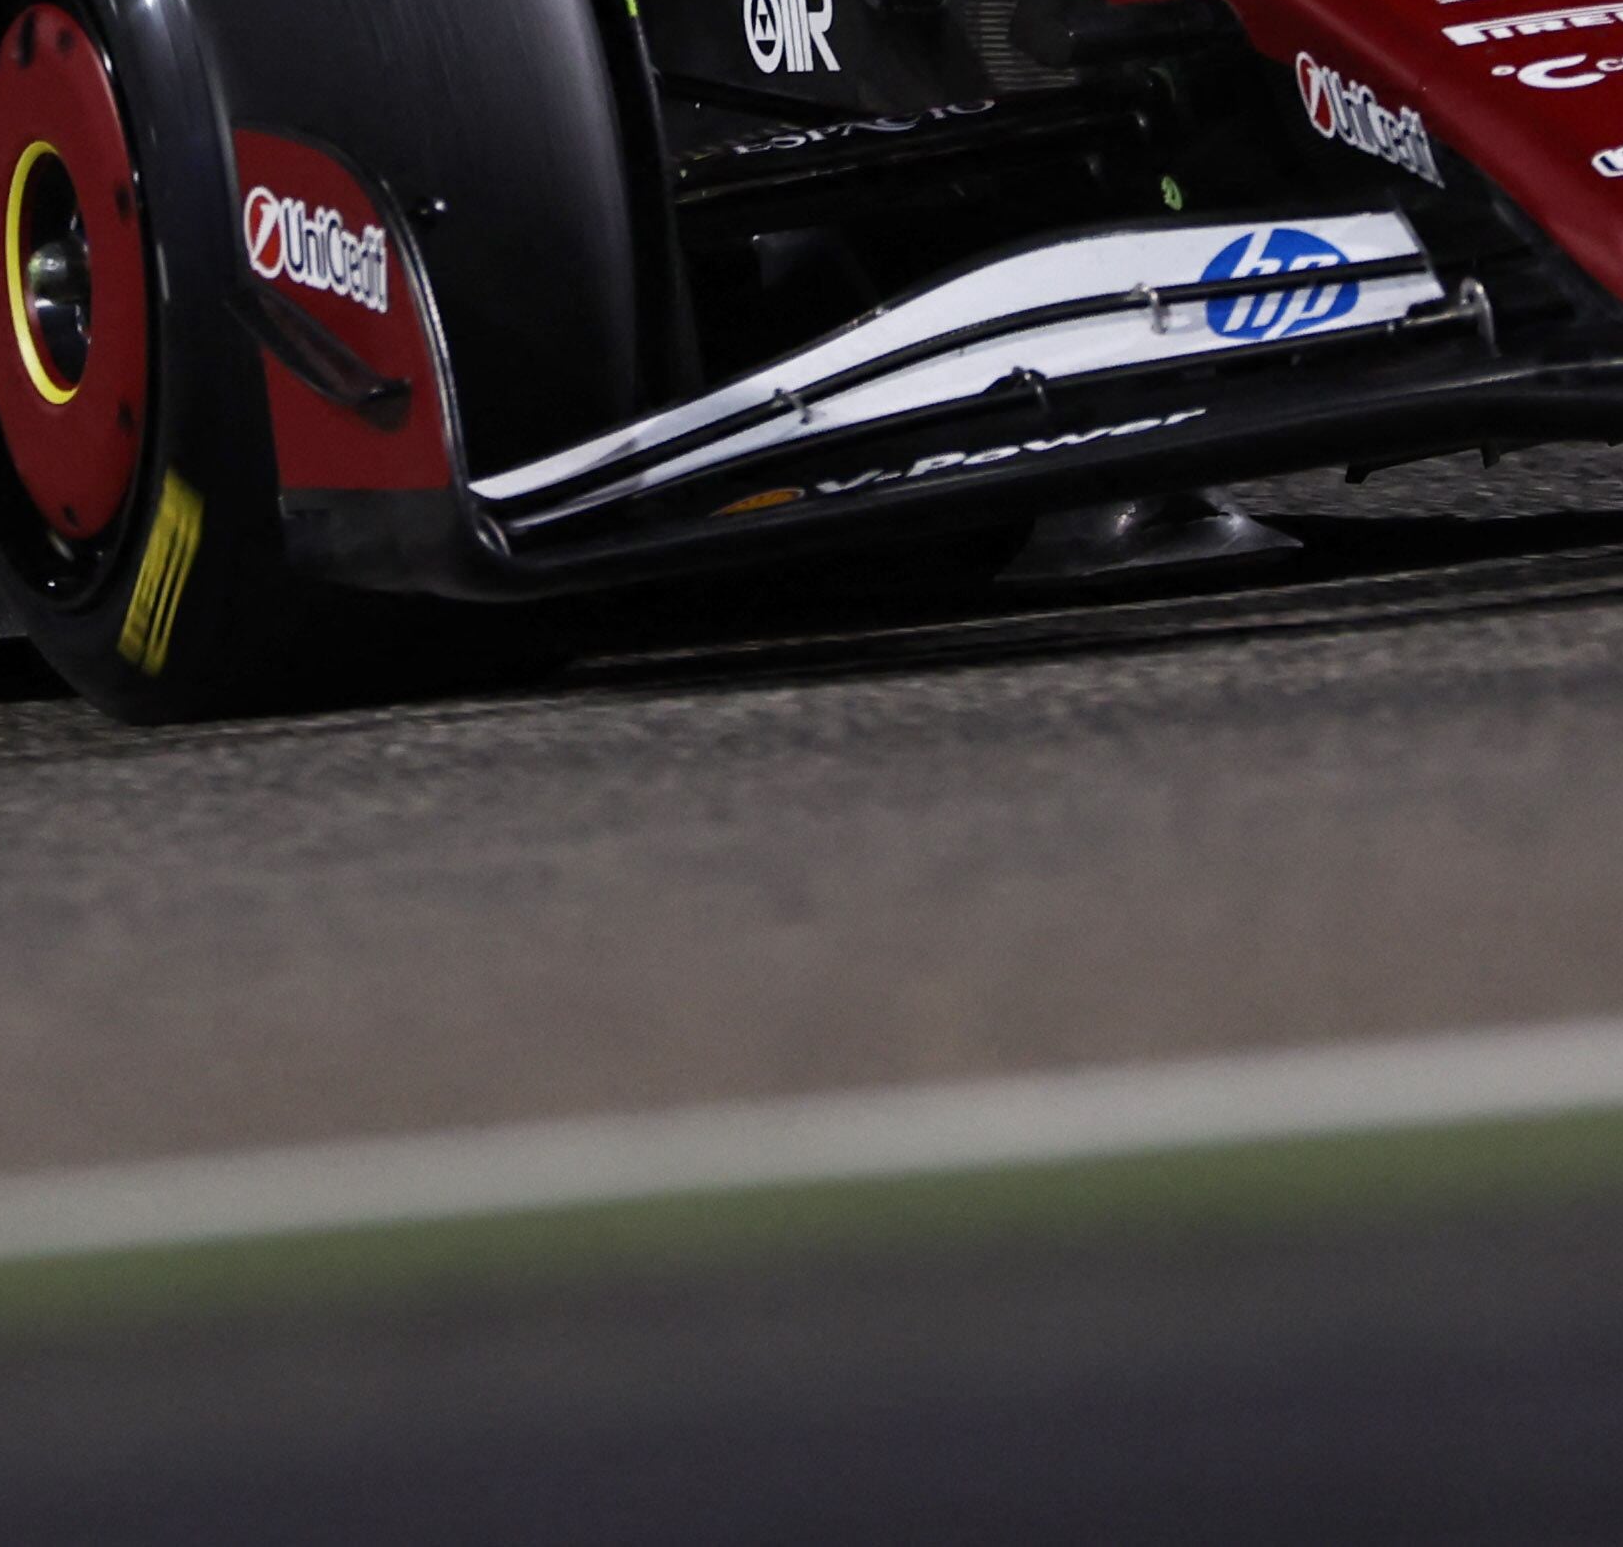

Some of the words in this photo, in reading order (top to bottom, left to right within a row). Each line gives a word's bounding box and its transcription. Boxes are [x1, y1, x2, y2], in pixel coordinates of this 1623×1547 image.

[1322, 65, 1445, 189] UniCredit
[280, 197, 388, 314] UniCredit
[1222, 228, 1344, 341] hp
[816, 408, 1207, 494] V-Power
